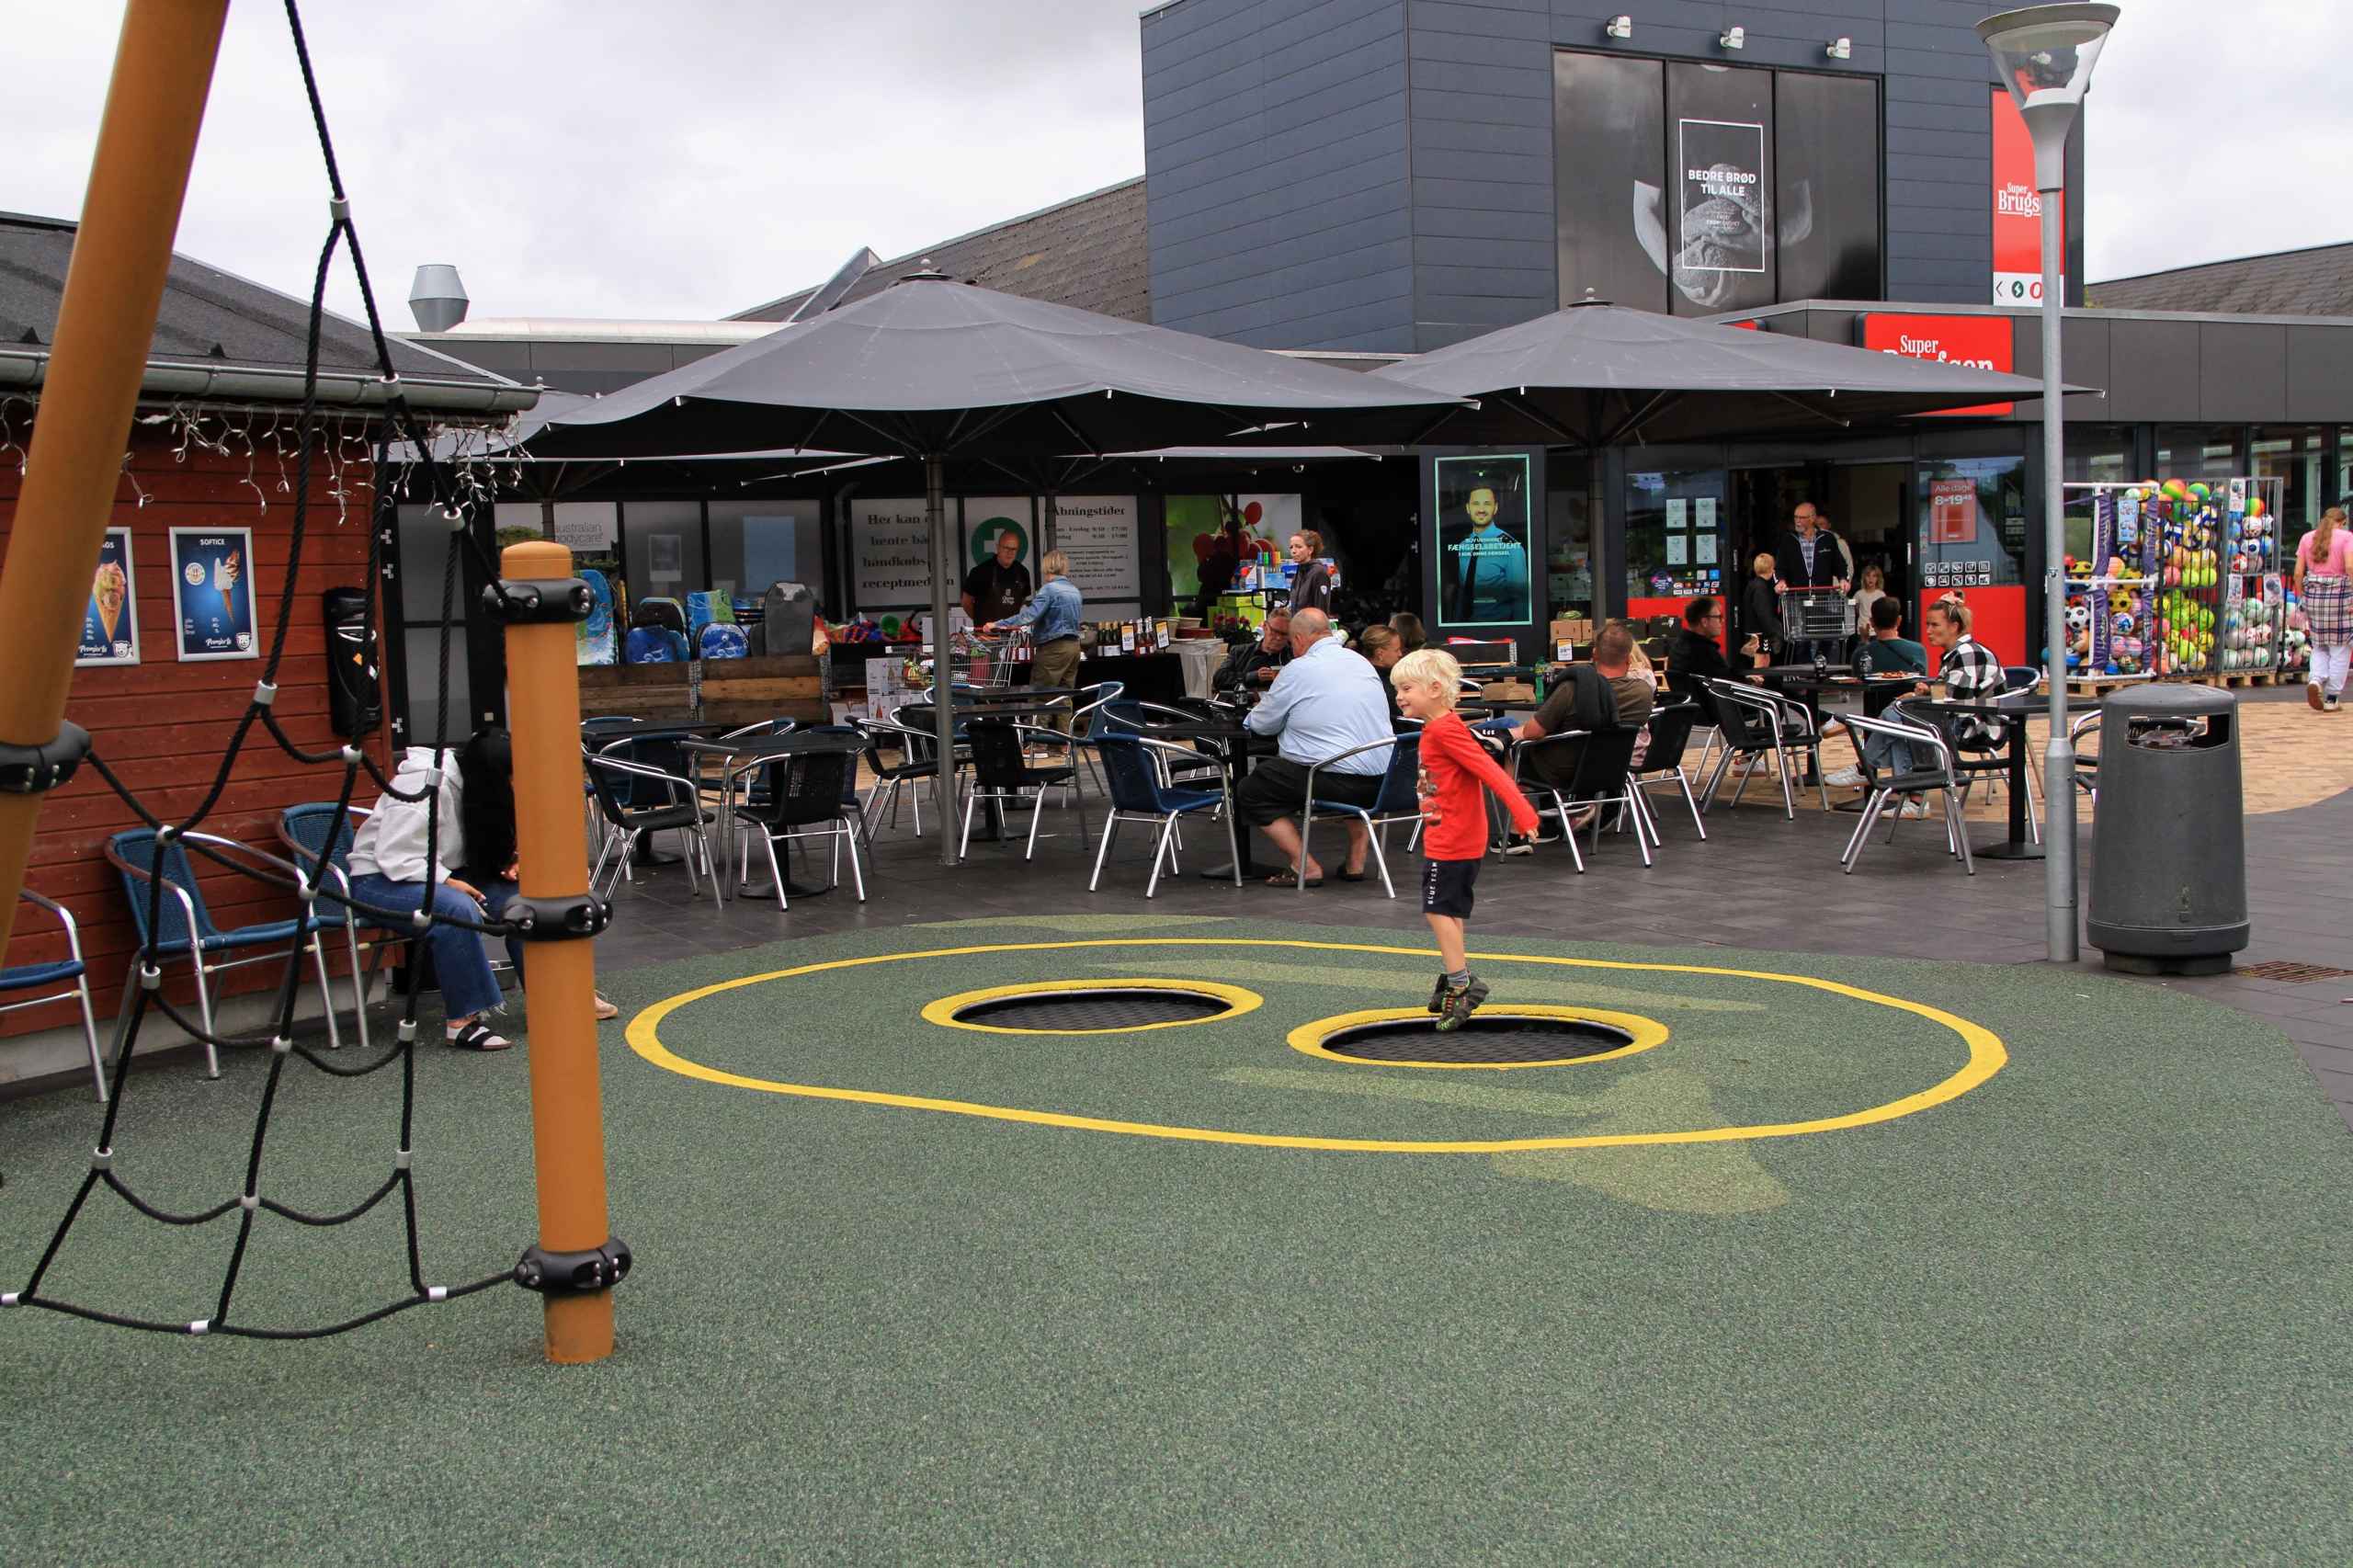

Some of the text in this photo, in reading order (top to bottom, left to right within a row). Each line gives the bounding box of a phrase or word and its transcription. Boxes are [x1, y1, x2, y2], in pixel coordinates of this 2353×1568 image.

[1688, 169, 1756, 184] BEDRE BRØD
[1700, 184, 1745, 197] TIL ALLE
[2006, 183, 2028, 195] Super
[1998, 189, 2040, 217] Brugs
[1900, 335, 1938, 358] Super
[896, 514, 920, 524] kan
[199, 538, 226, 546] SOFTICE
